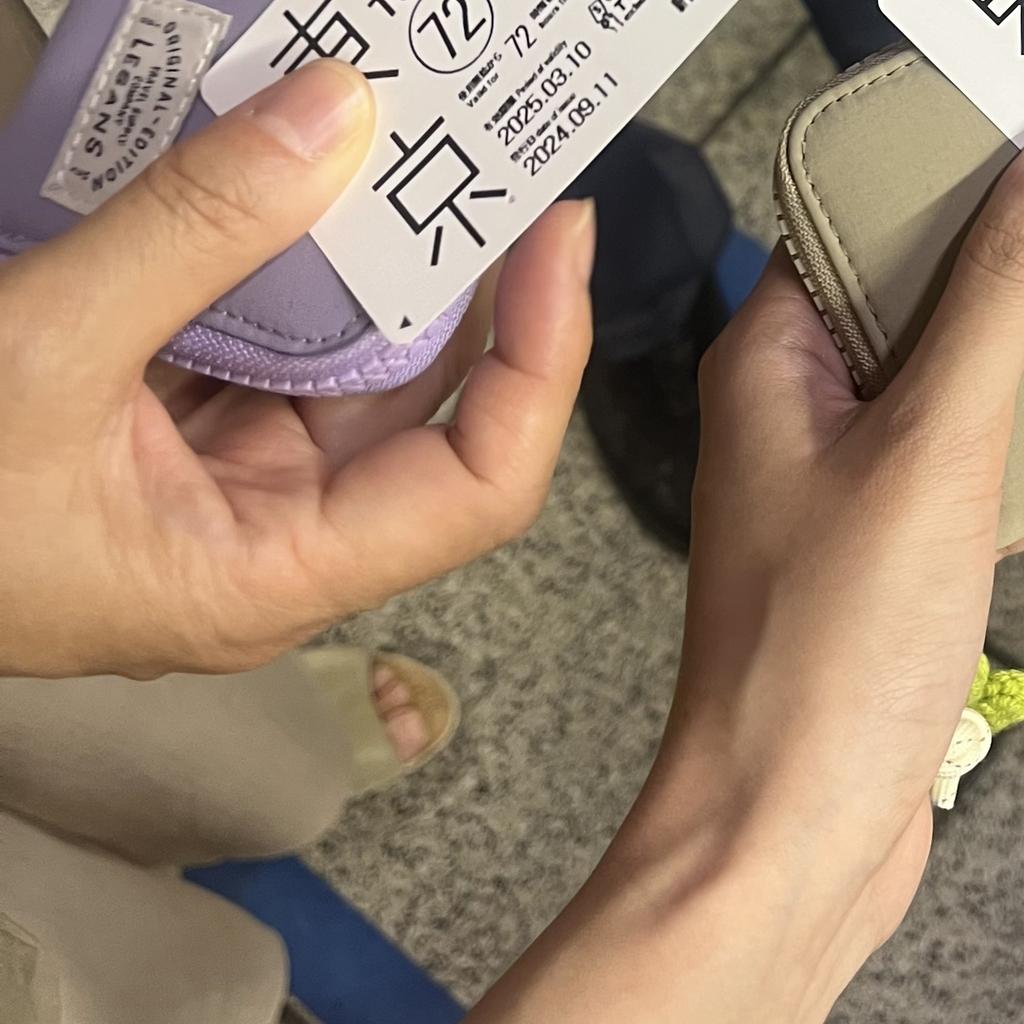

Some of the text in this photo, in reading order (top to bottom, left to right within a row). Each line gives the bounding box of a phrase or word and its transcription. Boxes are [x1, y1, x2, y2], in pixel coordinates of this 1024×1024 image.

[496, 40, 593, 147] 2025.03.10
[503, 24, 538, 59] 72
[522, 71, 619, 178] 2024.09.11
